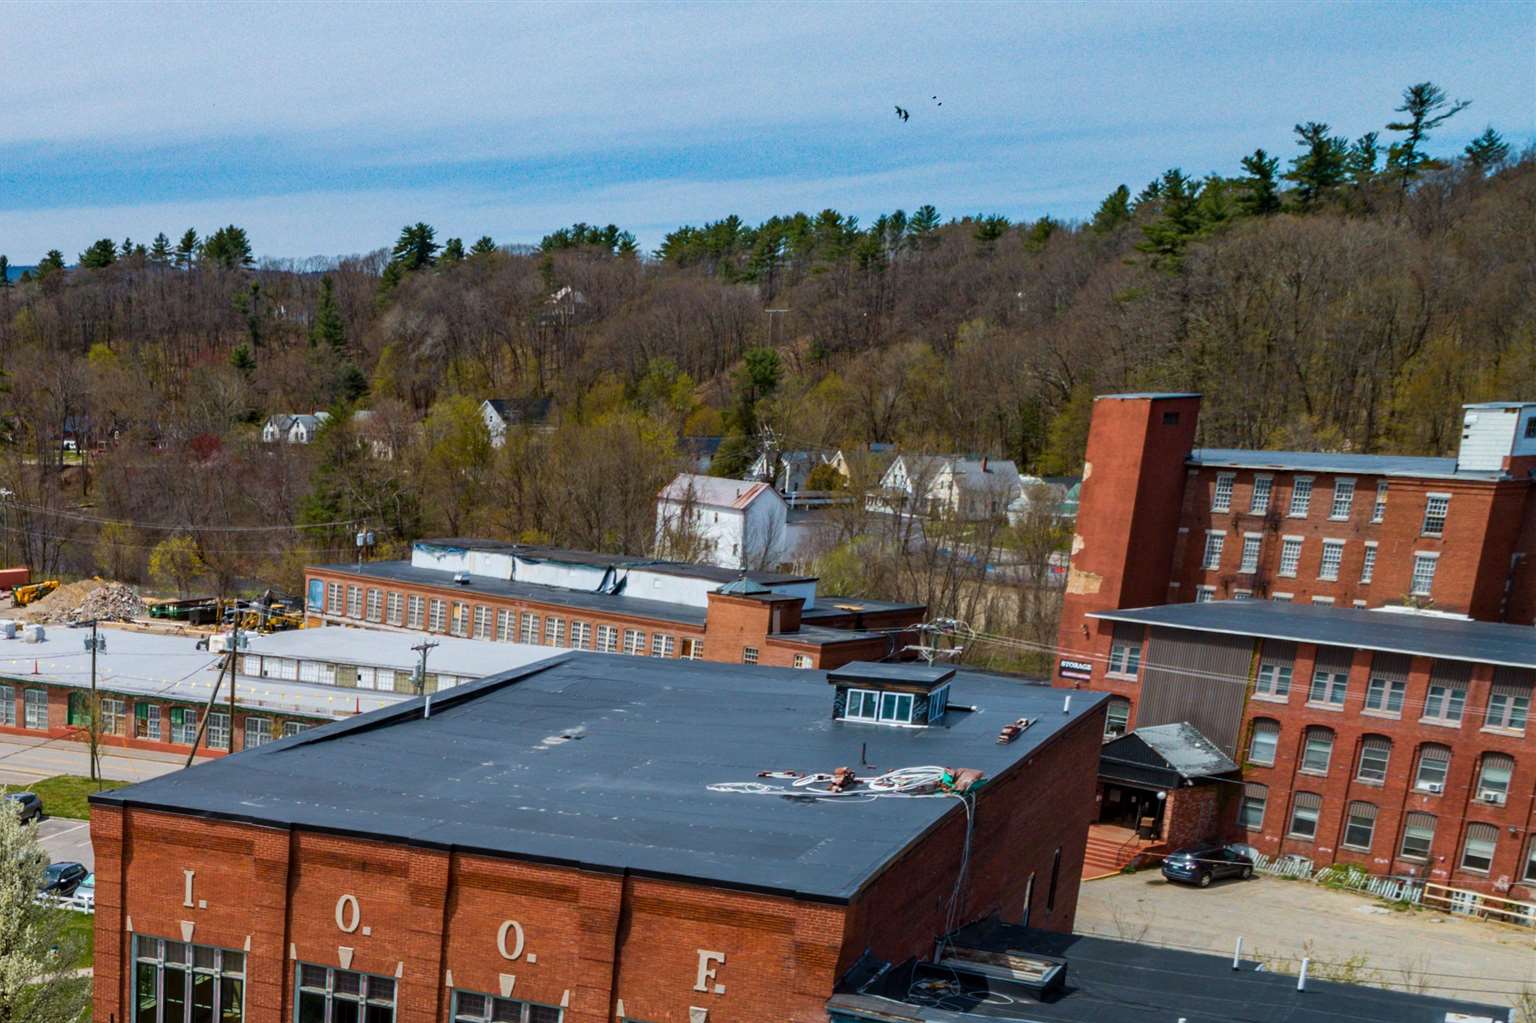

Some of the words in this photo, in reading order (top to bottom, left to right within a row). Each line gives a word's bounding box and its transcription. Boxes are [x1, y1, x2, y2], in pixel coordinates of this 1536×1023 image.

[183, 869, 208, 908] I.
[335, 894, 372, 936] O.
[497, 920, 537, 963] O.
[693, 949, 726, 994] F.
